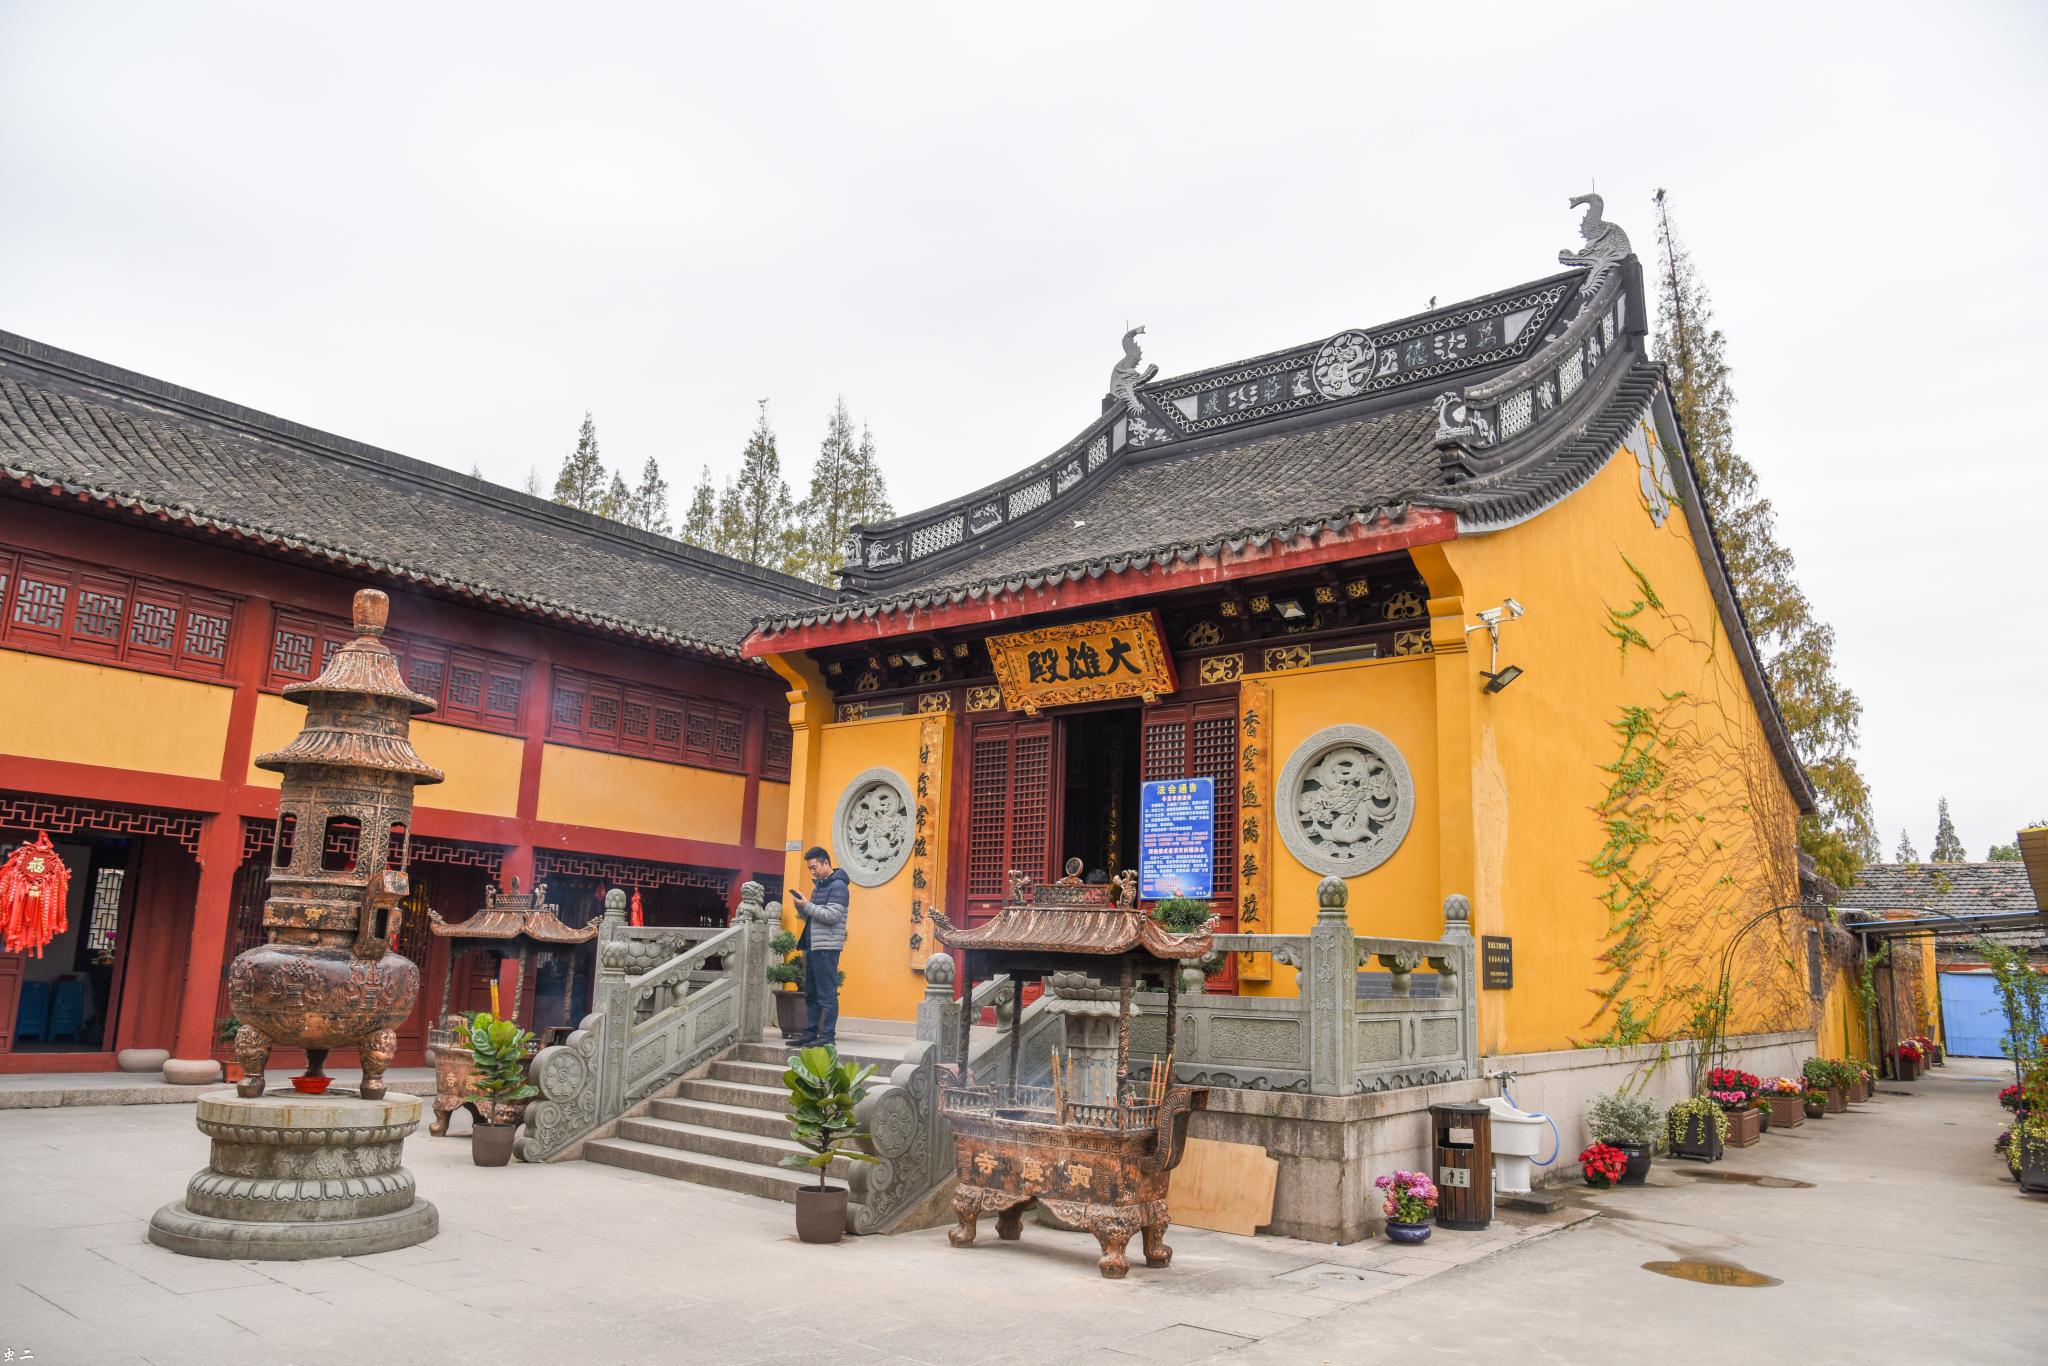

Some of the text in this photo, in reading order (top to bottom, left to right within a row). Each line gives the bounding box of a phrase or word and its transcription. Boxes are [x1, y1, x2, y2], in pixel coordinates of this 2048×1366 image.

[1027, 636, 1143, 684] 大雄殿
[1157, 783, 1198, 795] 法会通告
[26, 856, 45, 874] 福
[974, 1151, 1093, 1189] 寶慶寺
